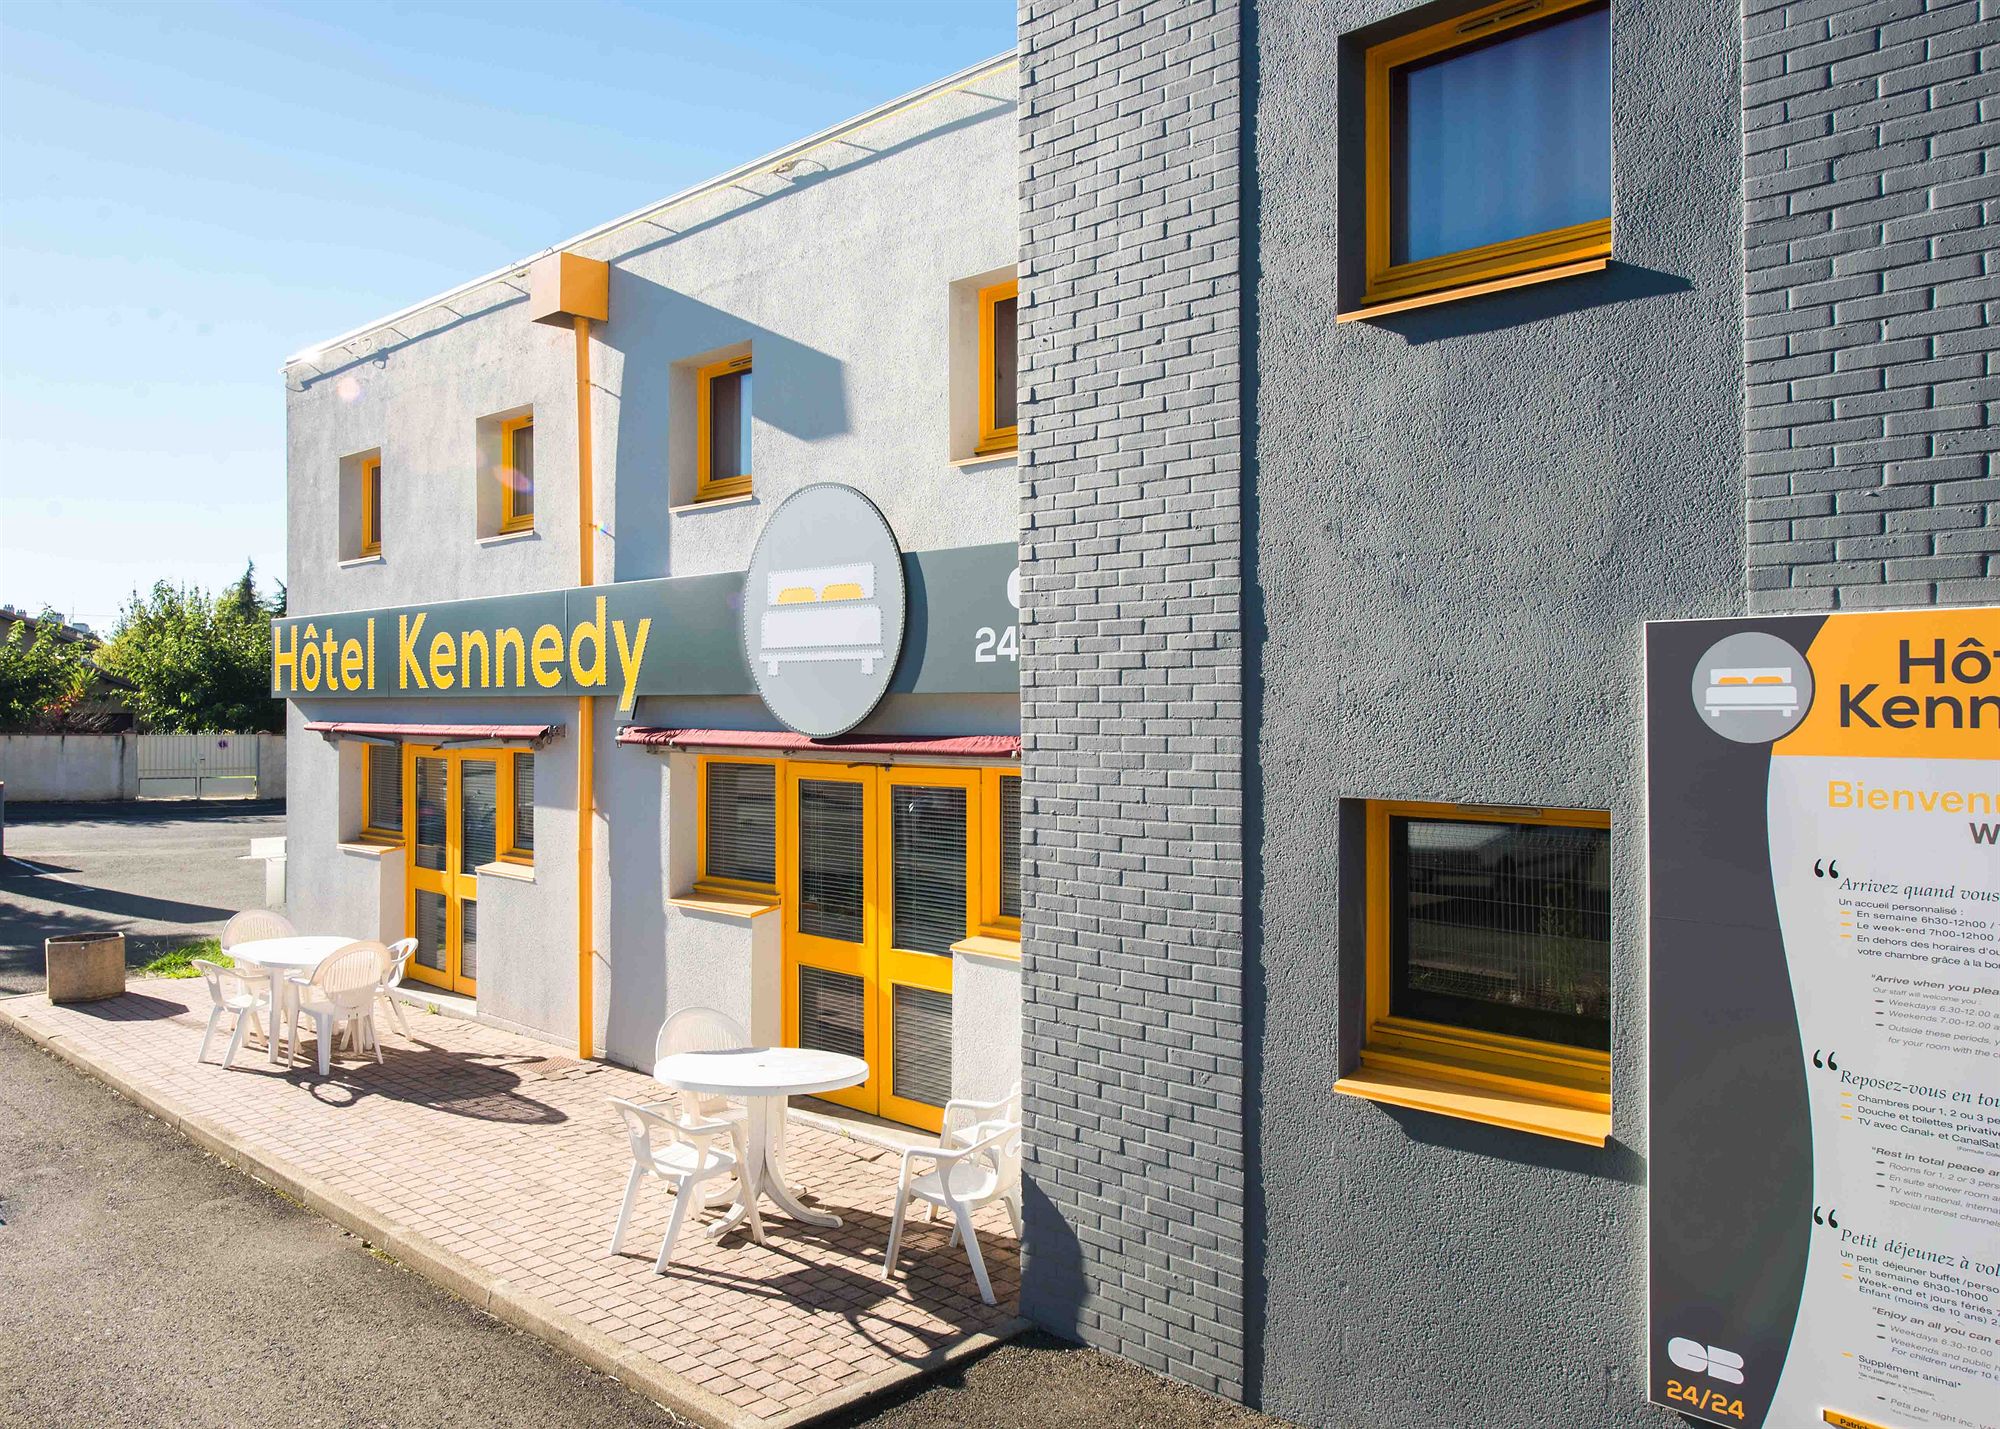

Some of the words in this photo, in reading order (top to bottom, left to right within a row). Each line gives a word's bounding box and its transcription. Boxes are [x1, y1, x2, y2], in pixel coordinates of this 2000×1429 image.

[274, 618, 375, 692] Hôtel
[399, 596, 652, 713] Kennedy
[1899, 637, 2000, 684] Hô
[1840, 683, 2000, 728] Kenn
[1828, 781, 2000, 814] Bienven
[1838, 878, 1899, 895] Arrivez
[1903, 885, 1955, 899] quand
[1960, 889, 2000, 902] vous
[1855, 902, 1889, 910] accueil
[1892, 903, 1957, 915] personnalisé
[1873, 913, 1918, 923] semaine
[1921, 917, 1986, 929] 6h30-12h00
[1857, 935, 1870, 943] En
[1873, 937, 1908, 947] dehors
[1910, 941, 1930, 949] des
[1932, 942, 1975, 954] horaires
[1873, 925, 1926, 935] week-end
[1929, 929, 1994, 942] 7h00-12h00
[1857, 949, 1882, 957] votre
[1885, 952, 1928, 962] chambre
[1931, 955, 1961, 966] grâce
[1963, 958, 1970, 966] à
[1973, 959, 1982, 968] la
[1913, 980, 1944, 989] when
[1889, 1000, 1936, 1011] Weekdays
[1923, 993, 1959, 1002] welcome
[1889, 1011, 1937, 1022] Weekends
[1888, 1024, 1922, 1034] Outside
[1926, 1029, 1951, 1038] these
[1903, 1039, 1923, 1047] your
[1926, 1043, 1950, 1051] room
[1953, 1046, 1972, 1055] with
[1840, 1070, 1947, 1099] Reposez-vous
[1952, 1090, 1971, 1102] en
[1858, 1094, 1909, 1109] Chambres
[1912, 1103, 1936, 1115] pour
[1960, 1112, 1973, 1121] ou
[1858, 1106, 1896, 1119] Douche
[1899, 1113, 1909, 1121] et
[1912, 1115, 1953, 1129] toilettes
[1858, 1118, 1871, 1126] TV
[1874, 1121, 1897, 1131] avec
[1939, 1133, 1948, 1141] et
[1952, 1134, 2000, 1150] CanalSat
[1889, 1162, 1921, 1174] Rooms
[1923, 1168, 1936, 1177] for
[1918, 1155, 1944, 1166] total
[1947, 1160, 1985, 1175] peace
[1889, 1174, 1901, 1182] En
[1903, 1178, 1925, 1186] suite
[1927, 1182, 1962, 1194] shower
[1964, 1189, 1989, 1199] room
[1889, 1185, 1902, 1193] TV
[1904, 1189, 1922, 1198] with
[1889, 1199, 1921, 1212] special
[1923, 1205, 1958, 1218] interest
[1841, 1228, 1878, 1248] Petit
[1884, 1239, 1955, 1267] déjeunez
[1960, 1256, 1969, 1270] à
[1840, 1250, 1853, 1259] Un
[1857, 1254, 1878, 1265] petit
[1882, 1259, 1927, 1276] déjeuner
[1930, 1270, 1961, 1284] buffet
[1858, 1265, 1872, 1274] En
[1875, 1270, 1920, 1286] semaine
[1923, 1280, 1988, 1302] 6h30-10h00
[1858, 1276, 1912, 1295] Week-end
[1916, 1290, 1926, 1299] et
[1930, 1294, 1958, 1307] jours
[1961, 1301, 1992, 1316] fériés
[1859, 1286, 1891, 1300] Enfant
[1932, 1304, 1945, 1313] de
[1949, 1308, 1960, 1317] 10
[1890, 1325, 1938, 1344] Weekdays
[1910, 1316, 1924, 1326] an
[1928, 1320, 1941, 1330] all
[1943, 1324, 1966, 1337] you
[1969, 1332, 1991, 1343] can
[1890, 1336, 1939, 1354] Weekends
[1941, 1351, 1960, 1361] and
[1963, 1357, 1991, 1370] public
[1891, 1347, 1907, 1356] For
[1909, 1352, 1947, 1367] children
[1950, 1363, 1978, 1377] under
[1981, 1371, 1992, 1379] 10
[1859, 1355, 1919, 1378] Supplément
[1667, 1379, 1744, 1420] 24/24
[1891, 1398, 1911, 1409] Pets
[1914, 1406, 1929, 1414] per
